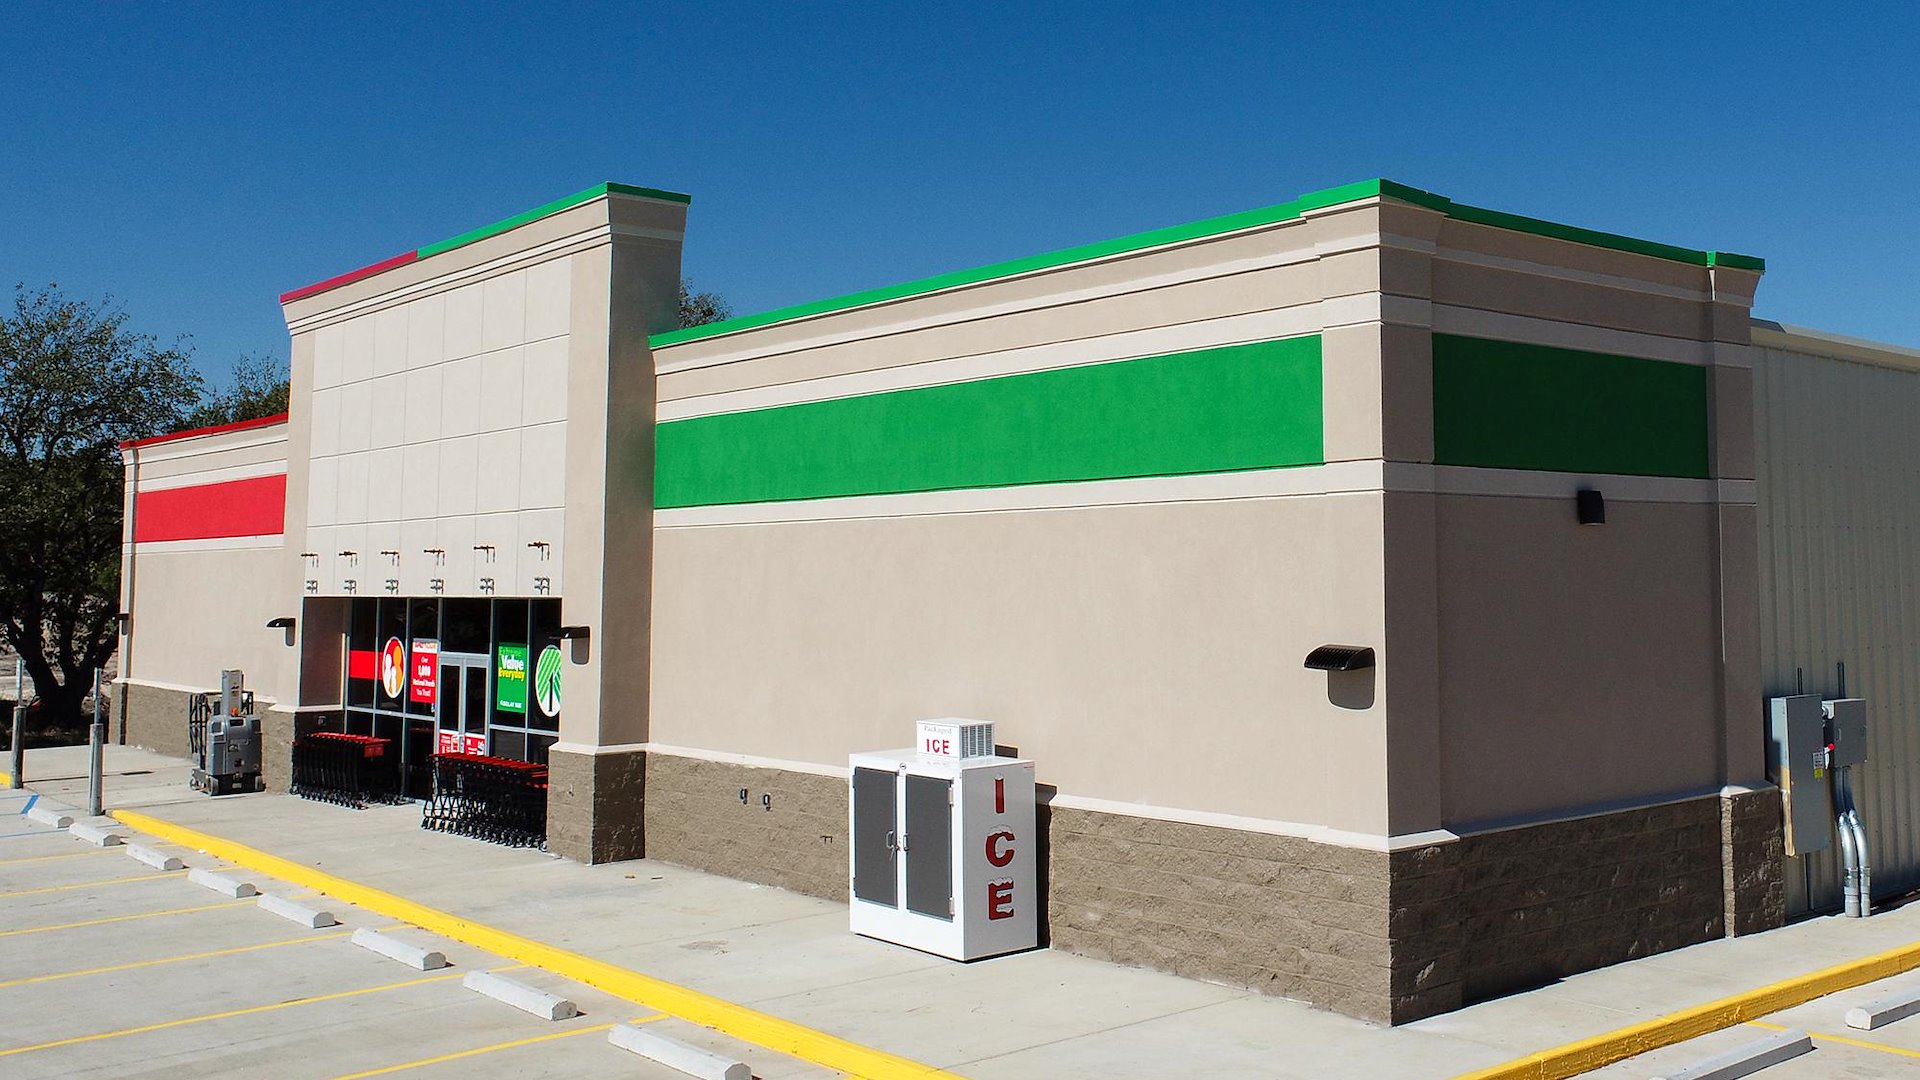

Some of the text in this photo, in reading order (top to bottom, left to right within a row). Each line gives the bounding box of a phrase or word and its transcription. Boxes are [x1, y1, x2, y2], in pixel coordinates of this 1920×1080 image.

[501, 654, 524, 670] Value
[499, 667, 525, 682] Everyday
[926, 738, 950, 755] ICE
[985, 773, 1015, 921] ICE
